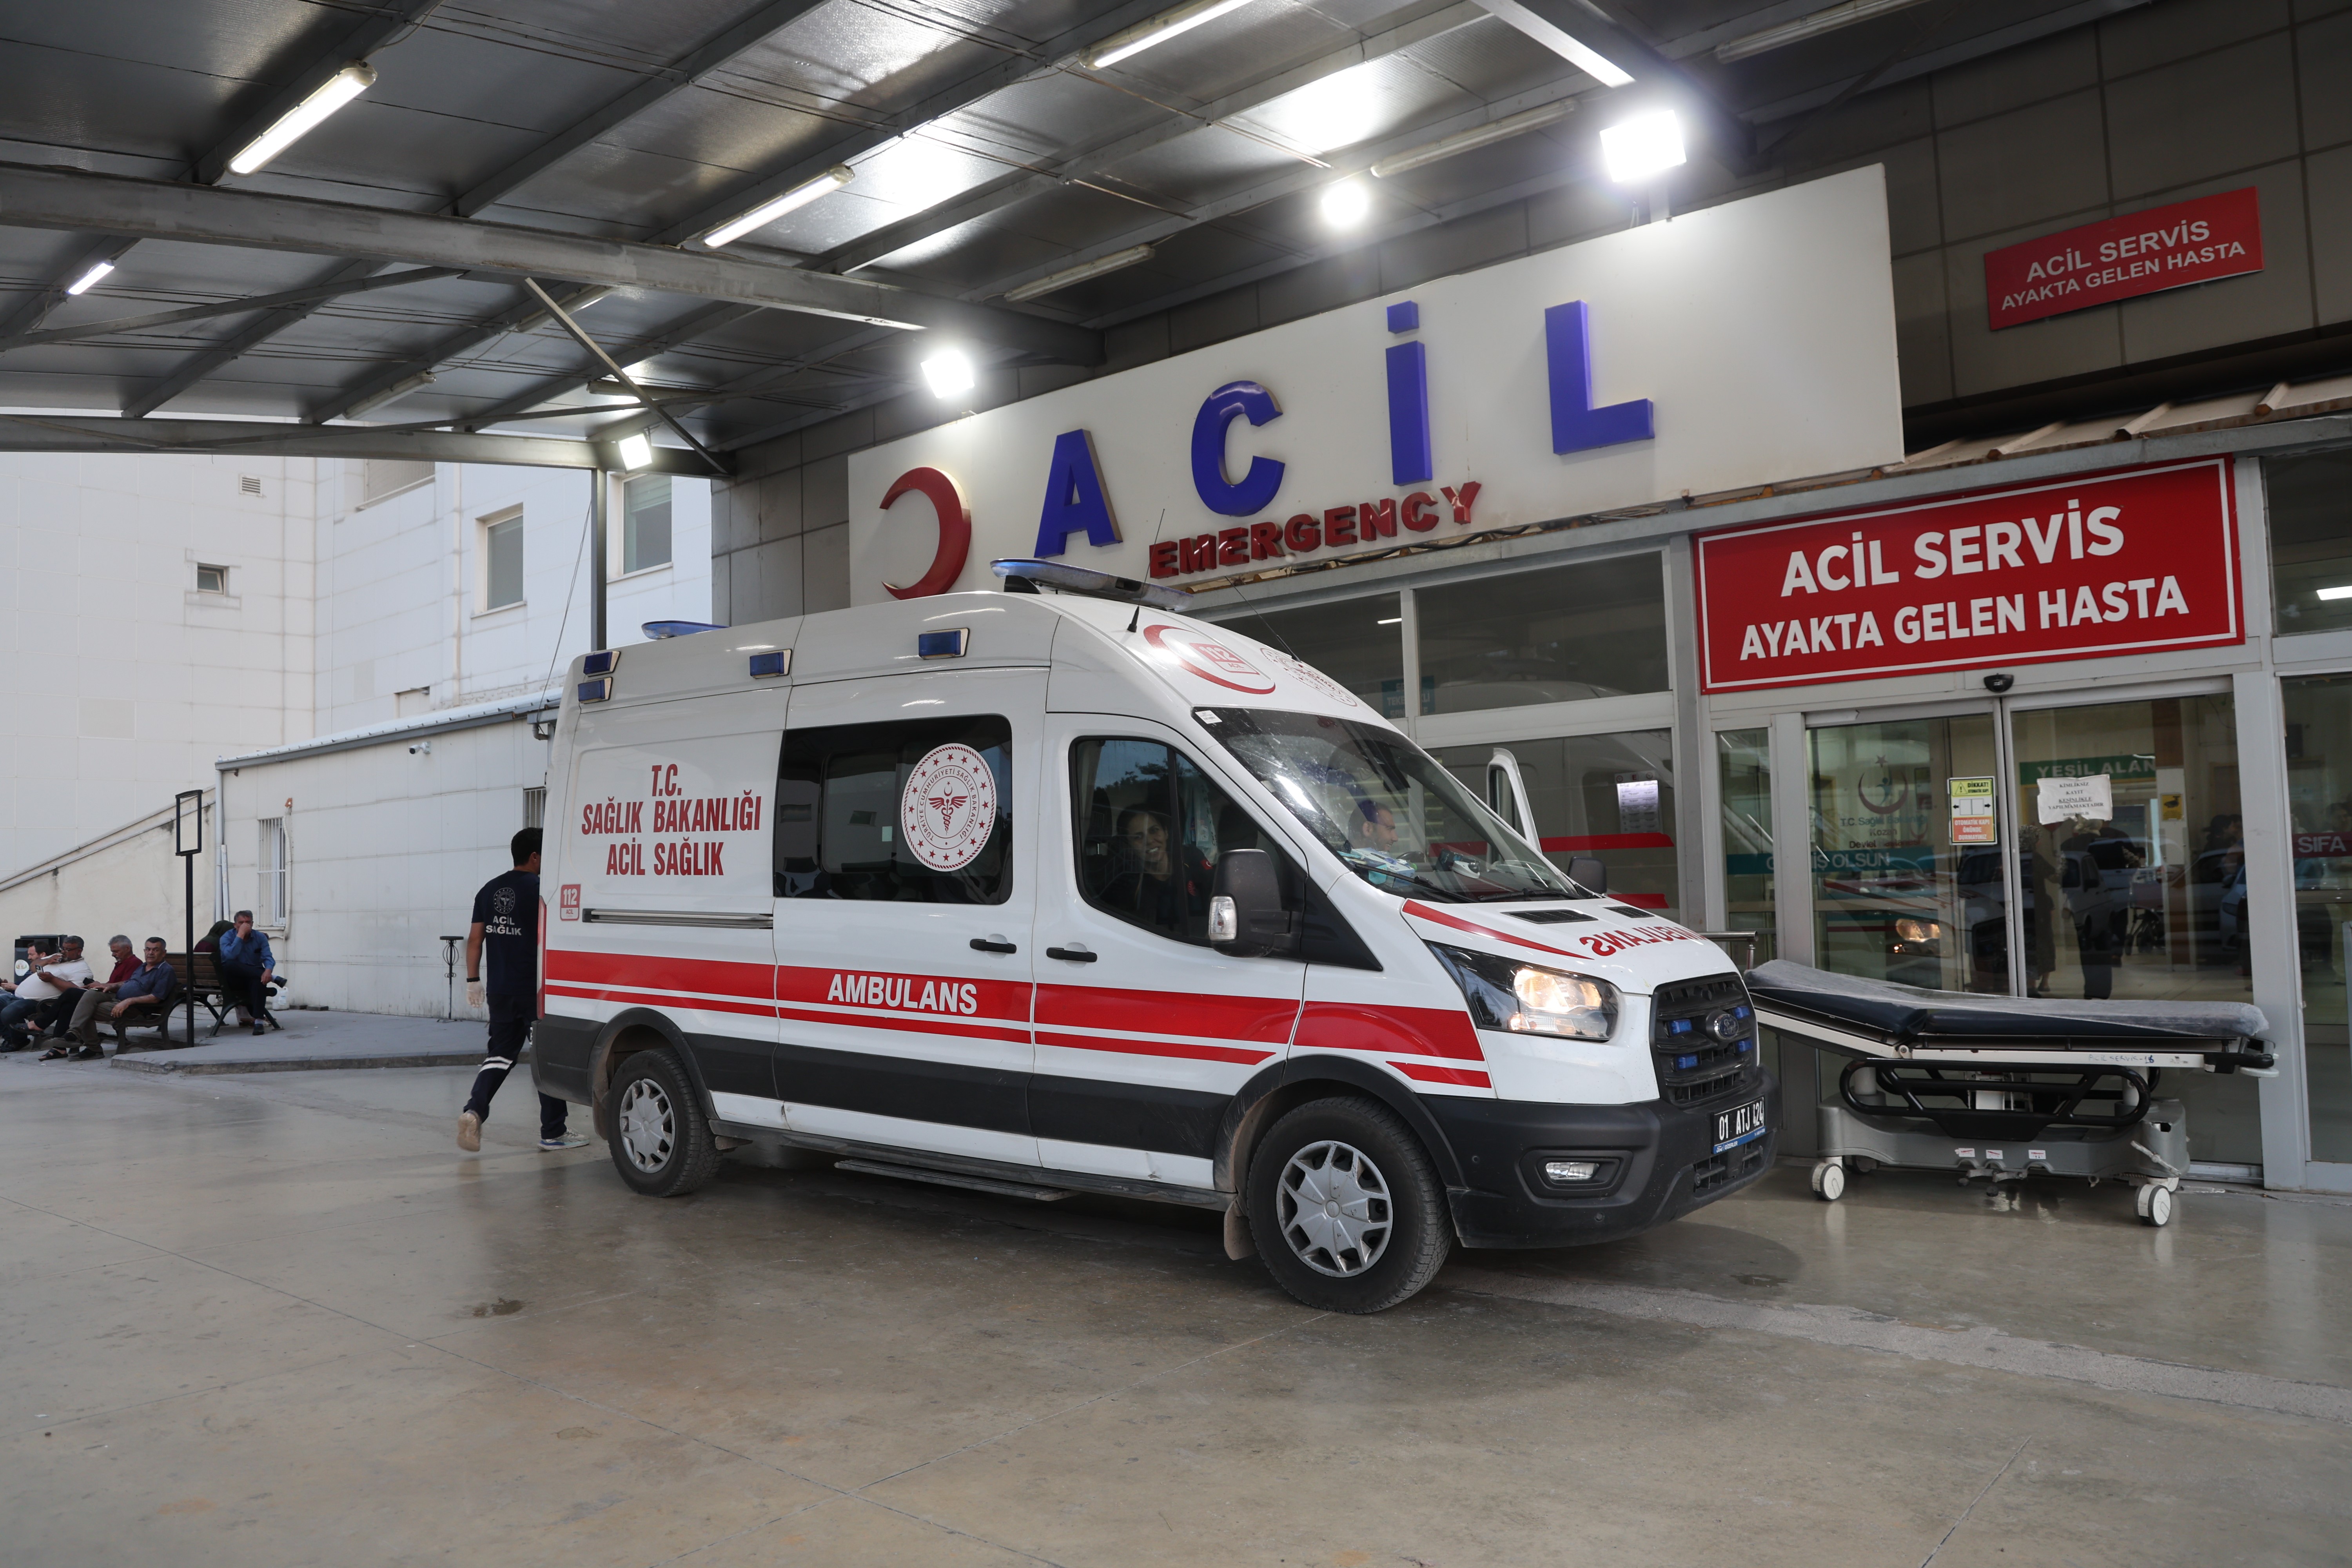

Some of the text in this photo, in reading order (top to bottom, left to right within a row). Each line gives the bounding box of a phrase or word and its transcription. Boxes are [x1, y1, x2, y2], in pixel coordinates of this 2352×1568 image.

[2026, 219, 2210, 283] ACİL SERVİS
[2001, 241, 2246, 311] AYAKTA GELEN HASTA
[1033, 299, 1655, 559] ACİL
[1149, 481, 1482, 579] EMERGENCY
[1780, 498, 2125, 597] ACİL SERVİS
[1739, 575, 2190, 661] AYAKTA GELEN HASTA
[1198, 646, 1240, 662] 112
[651, 763, 682, 797] T.C.
[2037, 759, 2156, 778] YEŞİL ALAN
[581, 789, 762, 835] SAĞLIK BAKANLIĞI
[919, 767, 977, 841] TÜRKİYE CUMHURİYETİ SAĞLIK BAKANLIĞI
[1869, 828, 1897, 836] Kozan
[606, 837, 724, 876] ACİL SAĞLIK
[1832, 852, 1891, 869] OLSUN
[563, 888, 578, 906] 112
[485, 924, 522, 936] SAĞLIK
[492, 915, 515, 926] ACİL
[827, 973, 978, 1015] AMBULANS
[1719, 1100, 1764, 1141] 01 ATJ 424
